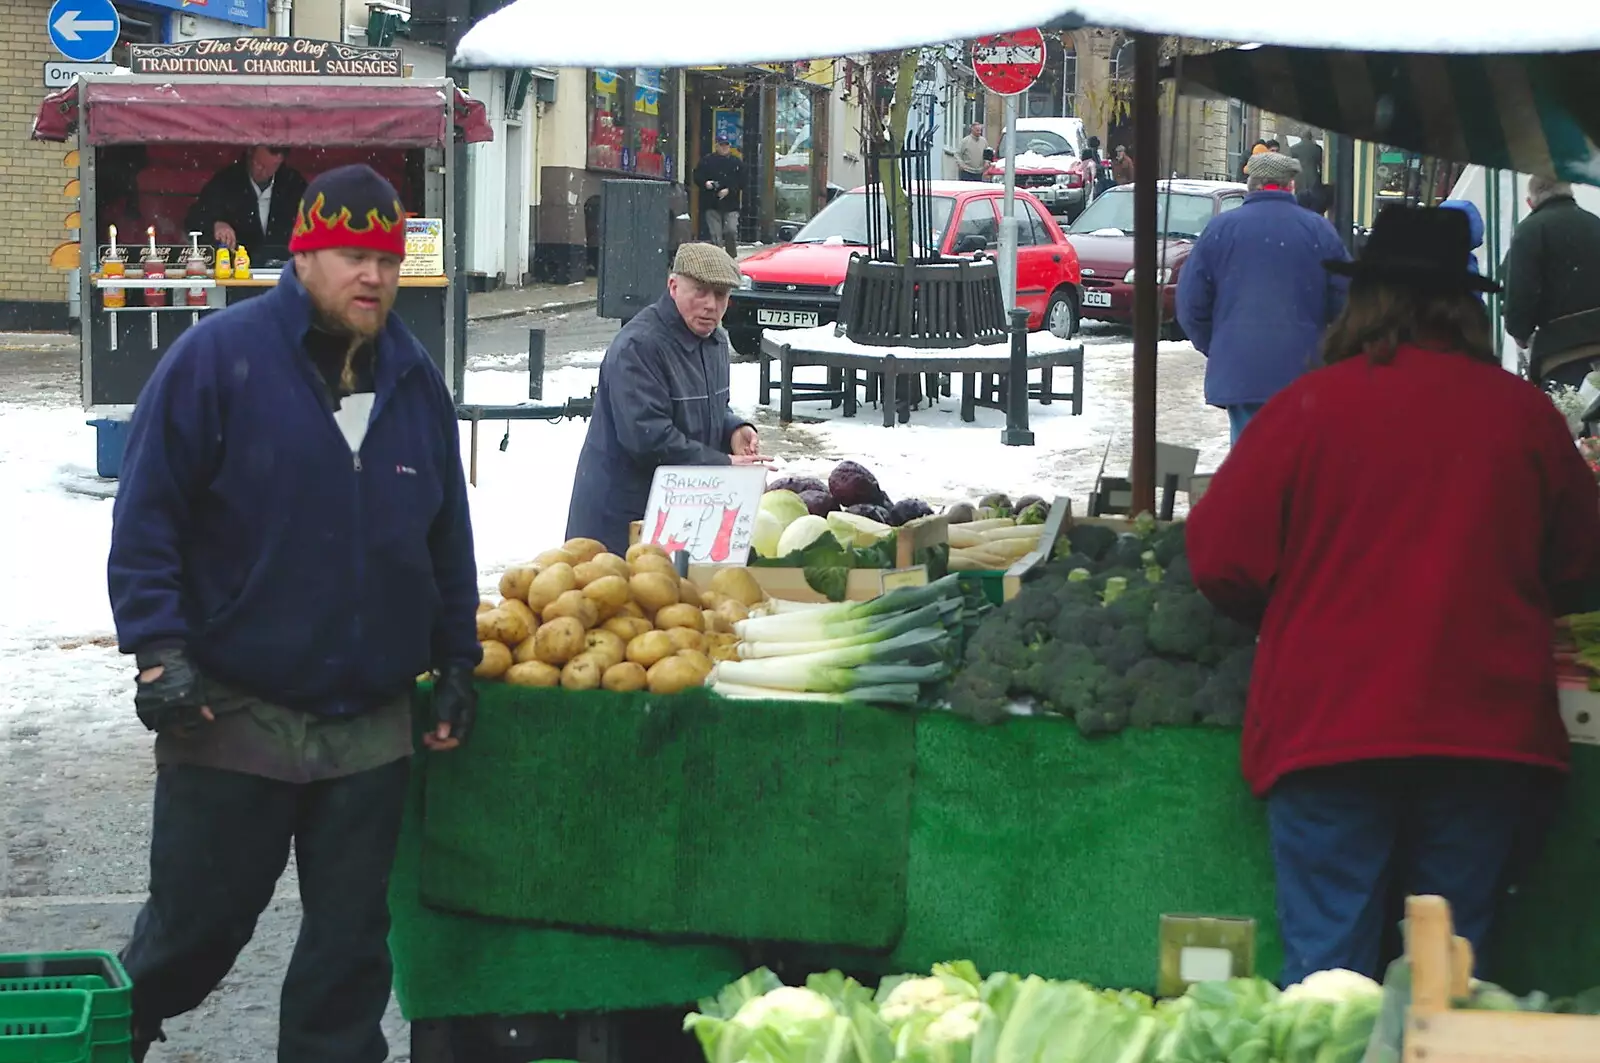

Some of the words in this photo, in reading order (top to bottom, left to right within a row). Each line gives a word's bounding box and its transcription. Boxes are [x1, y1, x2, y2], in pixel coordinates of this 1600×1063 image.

[195, 39, 232, 55] The
[234, 37, 289, 56] Flying
[293, 39, 329, 59] Chef
[137, 58, 239, 73] TRADITIONAL
[244, 59, 320, 73] CHARGRILL
[326, 60, 398, 74] SAUSAGES
[1087, 293, 1107, 305] CCL
[759, 310, 790, 323] L773
[794, 312, 817, 326] FPY
[661, 473, 724, 489] BAKING
[664, 491, 737, 505] POTATOES
